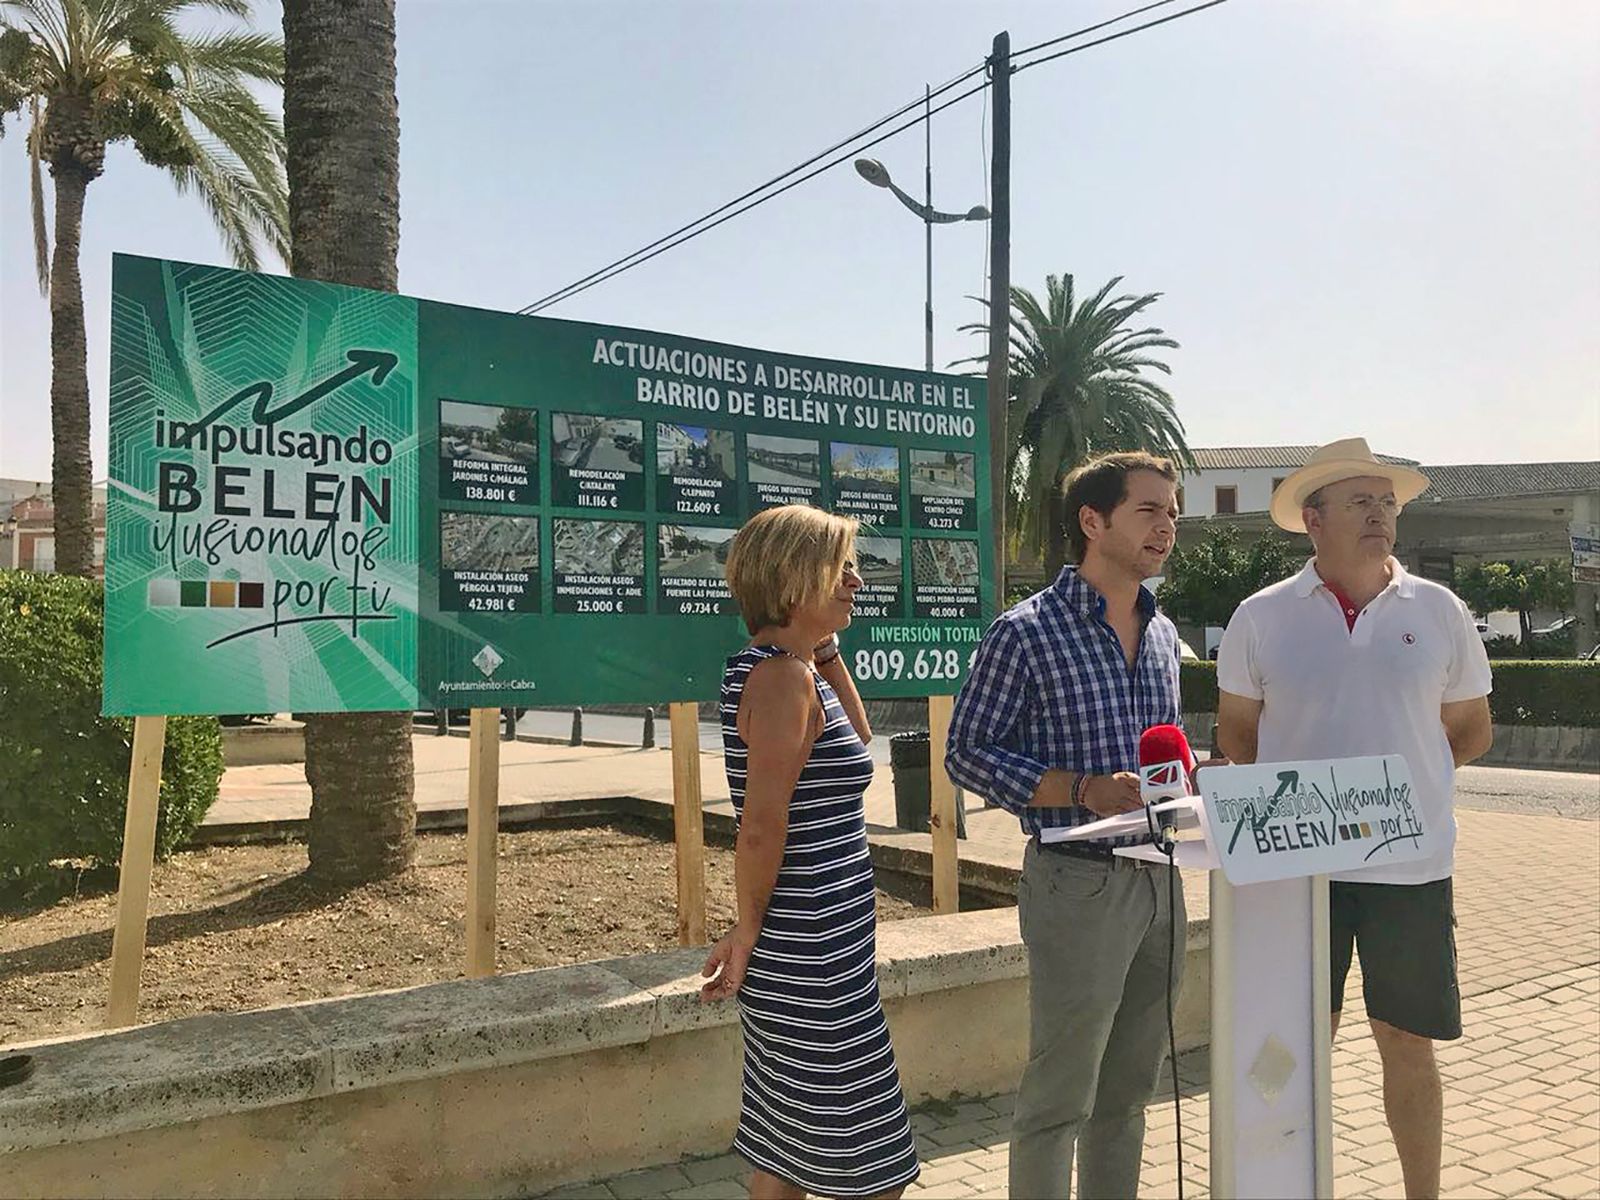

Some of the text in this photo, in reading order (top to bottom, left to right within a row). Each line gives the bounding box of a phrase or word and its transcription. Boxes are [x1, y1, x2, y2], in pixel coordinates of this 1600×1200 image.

[592, 338, 975, 409] ACTUACIONES A DESARROLLAR EN EL
[636, 377, 975, 438] BARRIO DE BELÉN Y SU ENTORNO
[156, 409, 392, 466] impulsando
[452, 459, 528, 474] REFORMA INTEGRAL
[452, 471, 488, 482] JARDINES
[569, 469, 626, 480] REMODELACIÓN
[466, 486, 504, 500] 138.801
[578, 494, 607, 507] 111.116
[677, 501, 712, 513] 122.609
[454, 571, 529, 582] INSTALACIÓN ASEOS
[565, 575, 610, 584] INSTALACIÓN
[459, 581, 495, 593] PÉRGOLA
[698, 579, 707, 587] DE
[708, 579, 717, 587] LA
[272, 554, 390, 638] por ti
[666, 589, 691, 597] FUENTE
[468, 598, 504, 610] 42.981
[577, 600, 613, 612] 25.000
[680, 602, 711, 614] 69.734
[930, 607, 957, 617] 40.000
[871, 622, 982, 642] INVERSIÓN TOTAL
[855, 649, 960, 680] 809.628
[1213, 783, 1322, 830] impulsando
[1380, 814, 1401, 853] por
